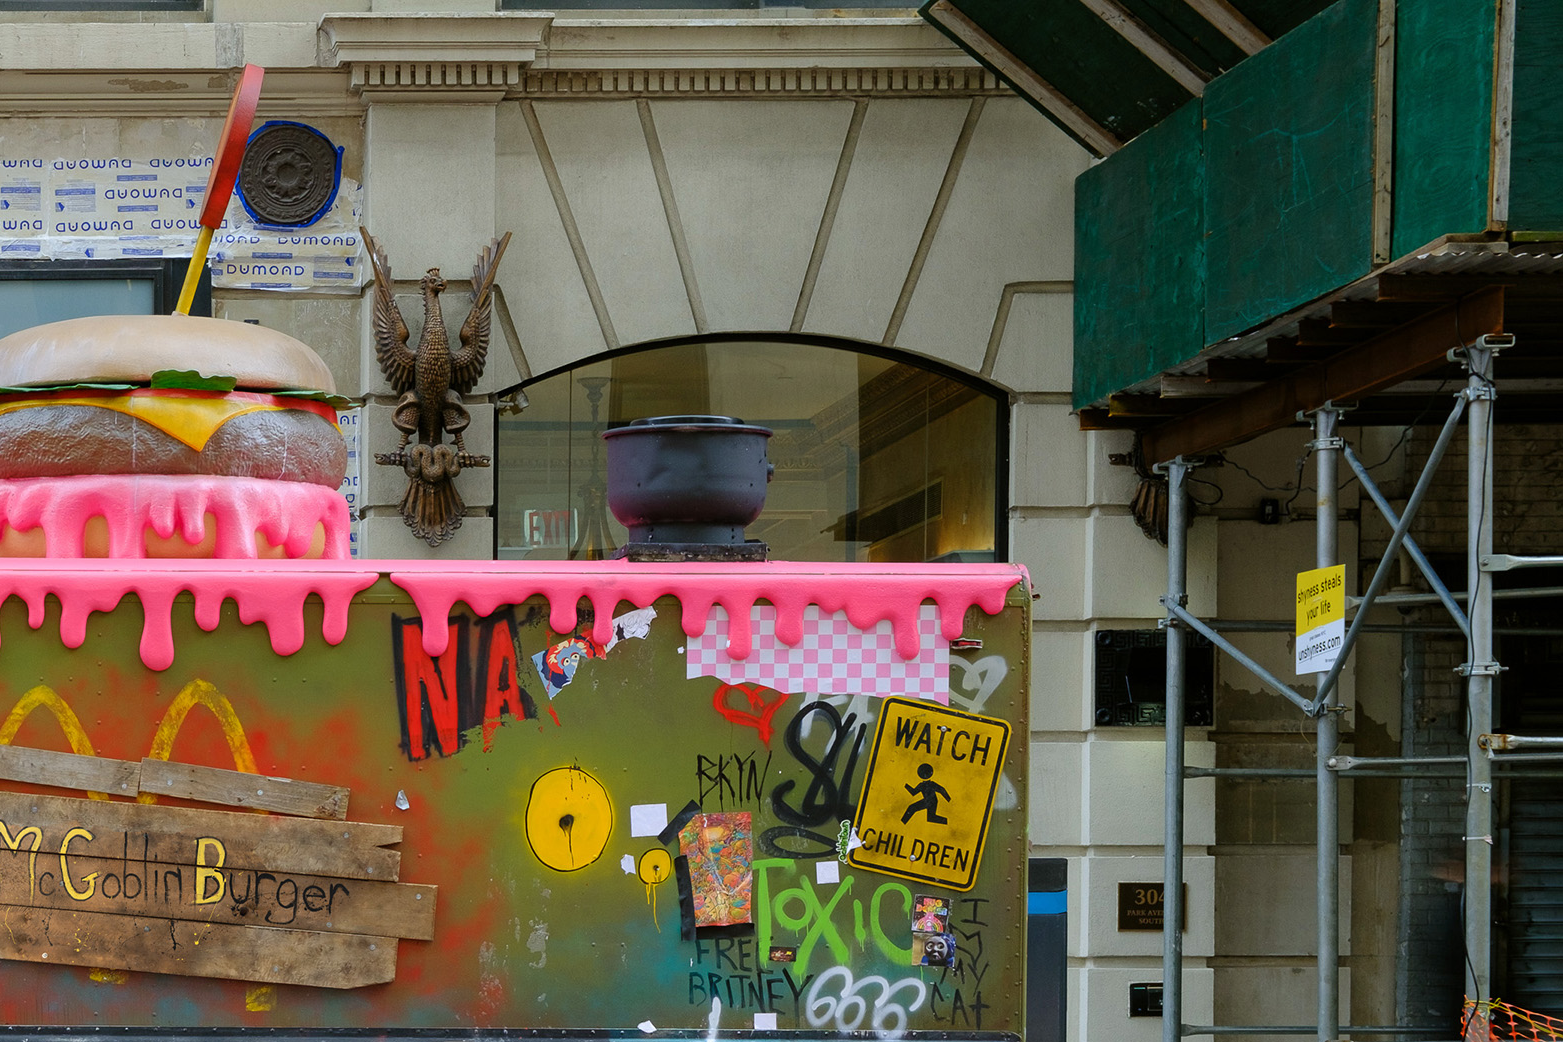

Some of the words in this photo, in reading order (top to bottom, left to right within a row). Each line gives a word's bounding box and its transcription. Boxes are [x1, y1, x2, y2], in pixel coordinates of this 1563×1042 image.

[149, 157, 215, 168] UMOND
[150, 219, 228, 230] DMOND
[529, 510, 571, 546] EXIT
[1297, 583, 1319, 606] shyness
[1320, 573, 1342, 594] steals
[1306, 605, 1319, 627] your
[1320, 599, 1332, 616] life
[1298, 635, 1341, 661] unshyness.com
[894, 716, 992, 767] WATCH
[696, 750, 773, 814] BKYN
[861, 827, 970, 873] CHILDREN
[1127, 909, 1146, 917] PARK
[1148, 909, 1165, 917] AVE
[688, 967, 814, 1028] BRITNEY
[806, 966, 926, 1040] 666
